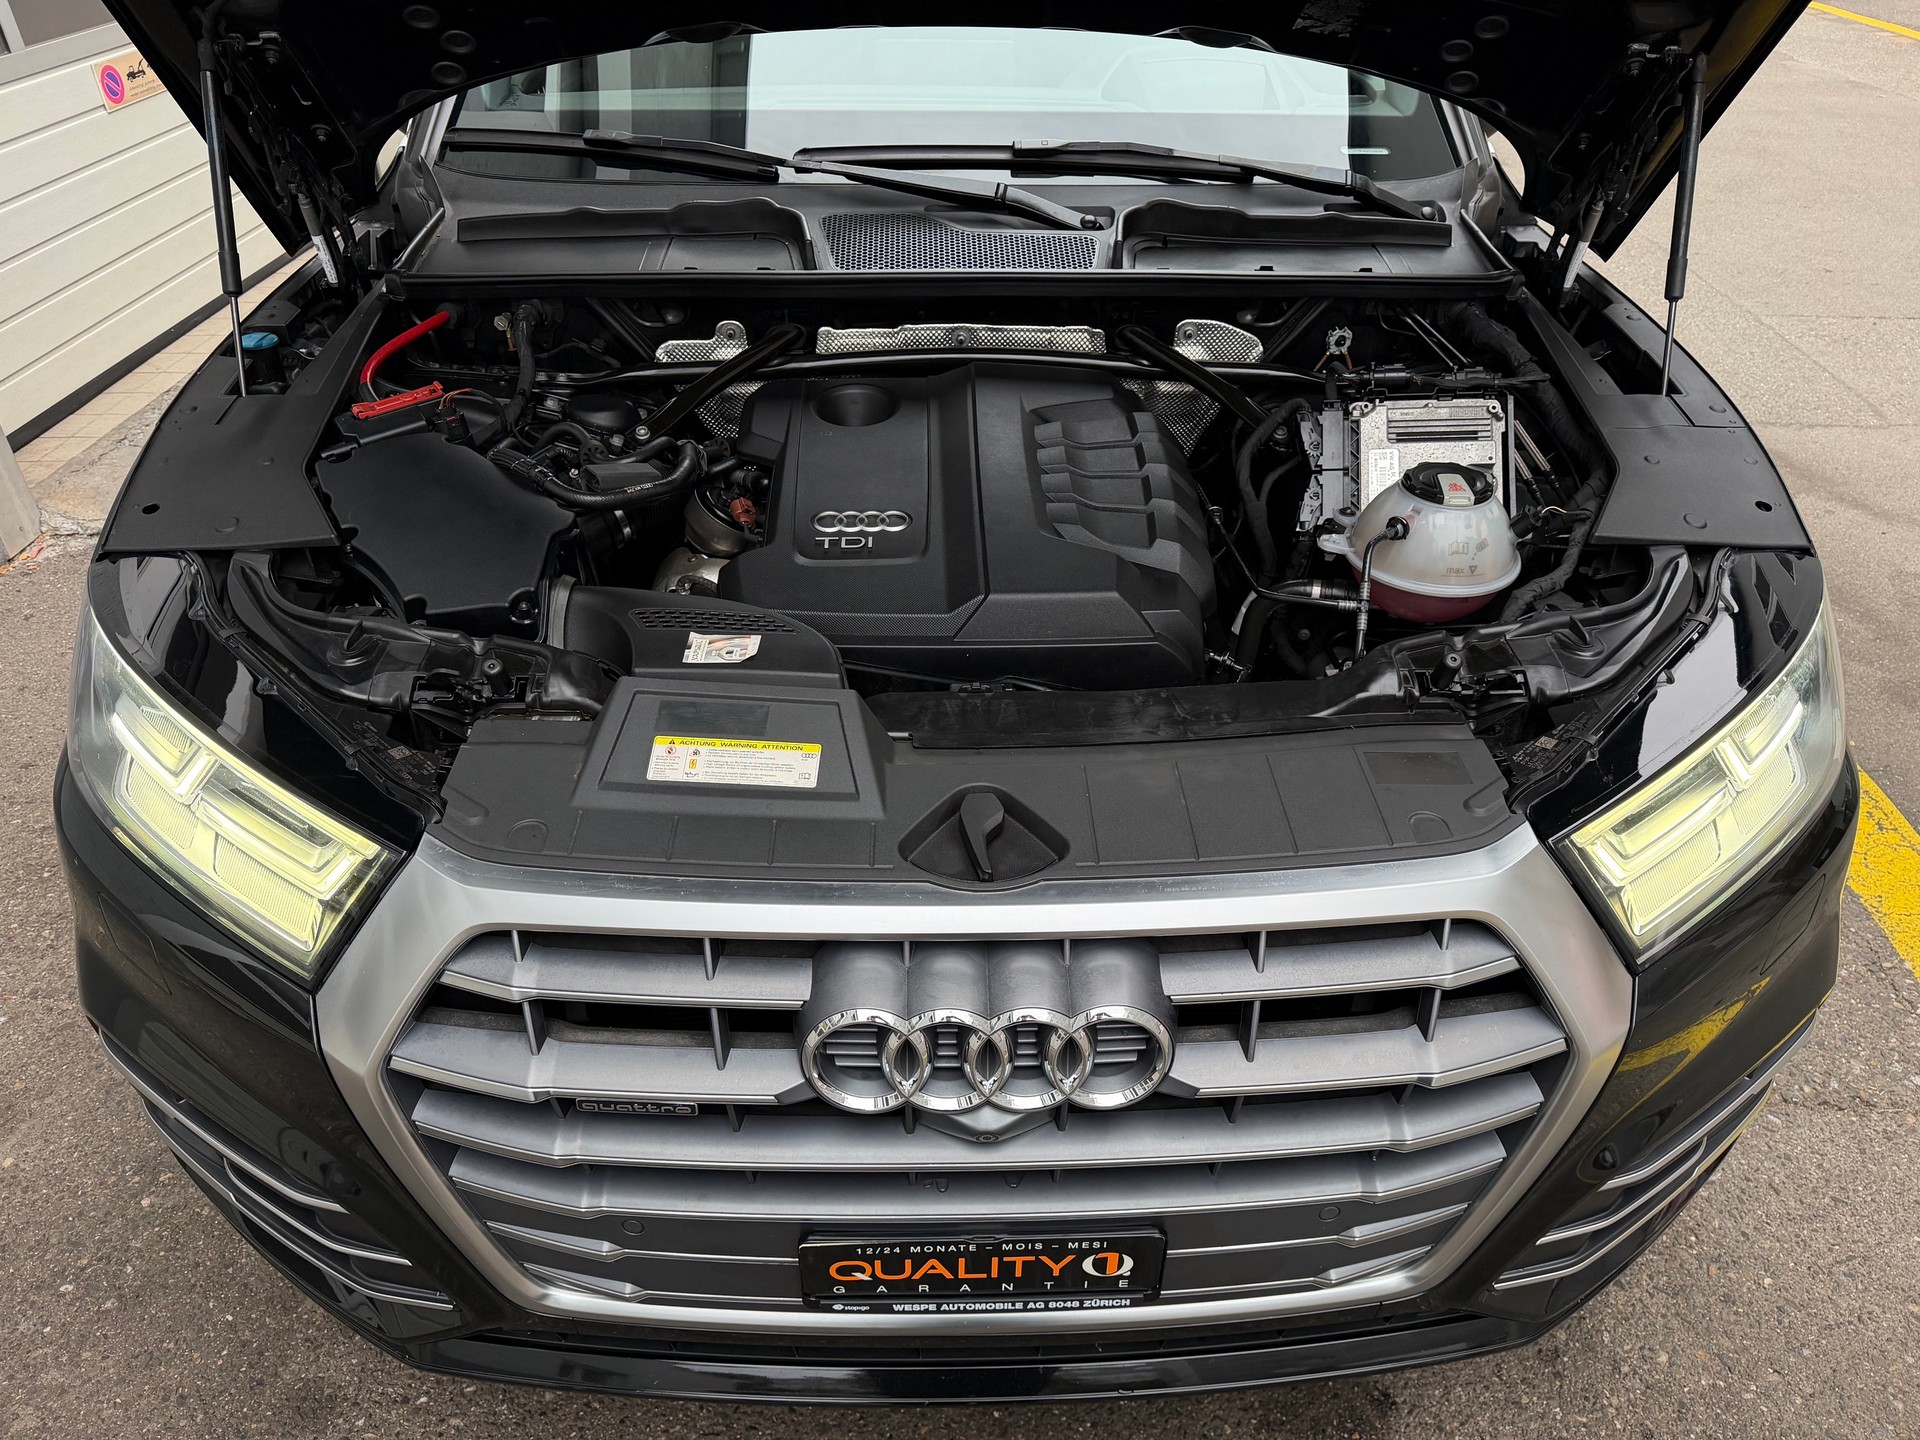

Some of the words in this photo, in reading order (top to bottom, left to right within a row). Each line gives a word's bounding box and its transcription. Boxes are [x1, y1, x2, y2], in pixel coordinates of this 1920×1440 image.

[815, 536, 873, 549] TDI
[679, 739, 716, 747] ACHTUNG
[582, 1103, 692, 1113] quattro
[856, 1246, 900, 1255] 12/24
[910, 1244, 977, 1253] MONATE
[1002, 1242, 1043, 1251] MOIS
[1068, 1241, 1107, 1249] MESI
[829, 1254, 1077, 1281] QUALITY
[833, 1279, 1129, 1293] GARANTIE
[892, 1303, 937, 1311] WESPE
[940, 1302, 1023, 1311] AUTOMOBILE
[1027, 1302, 1045, 1310] AG
[1083, 1299, 1131, 1308] ZÜRICH
